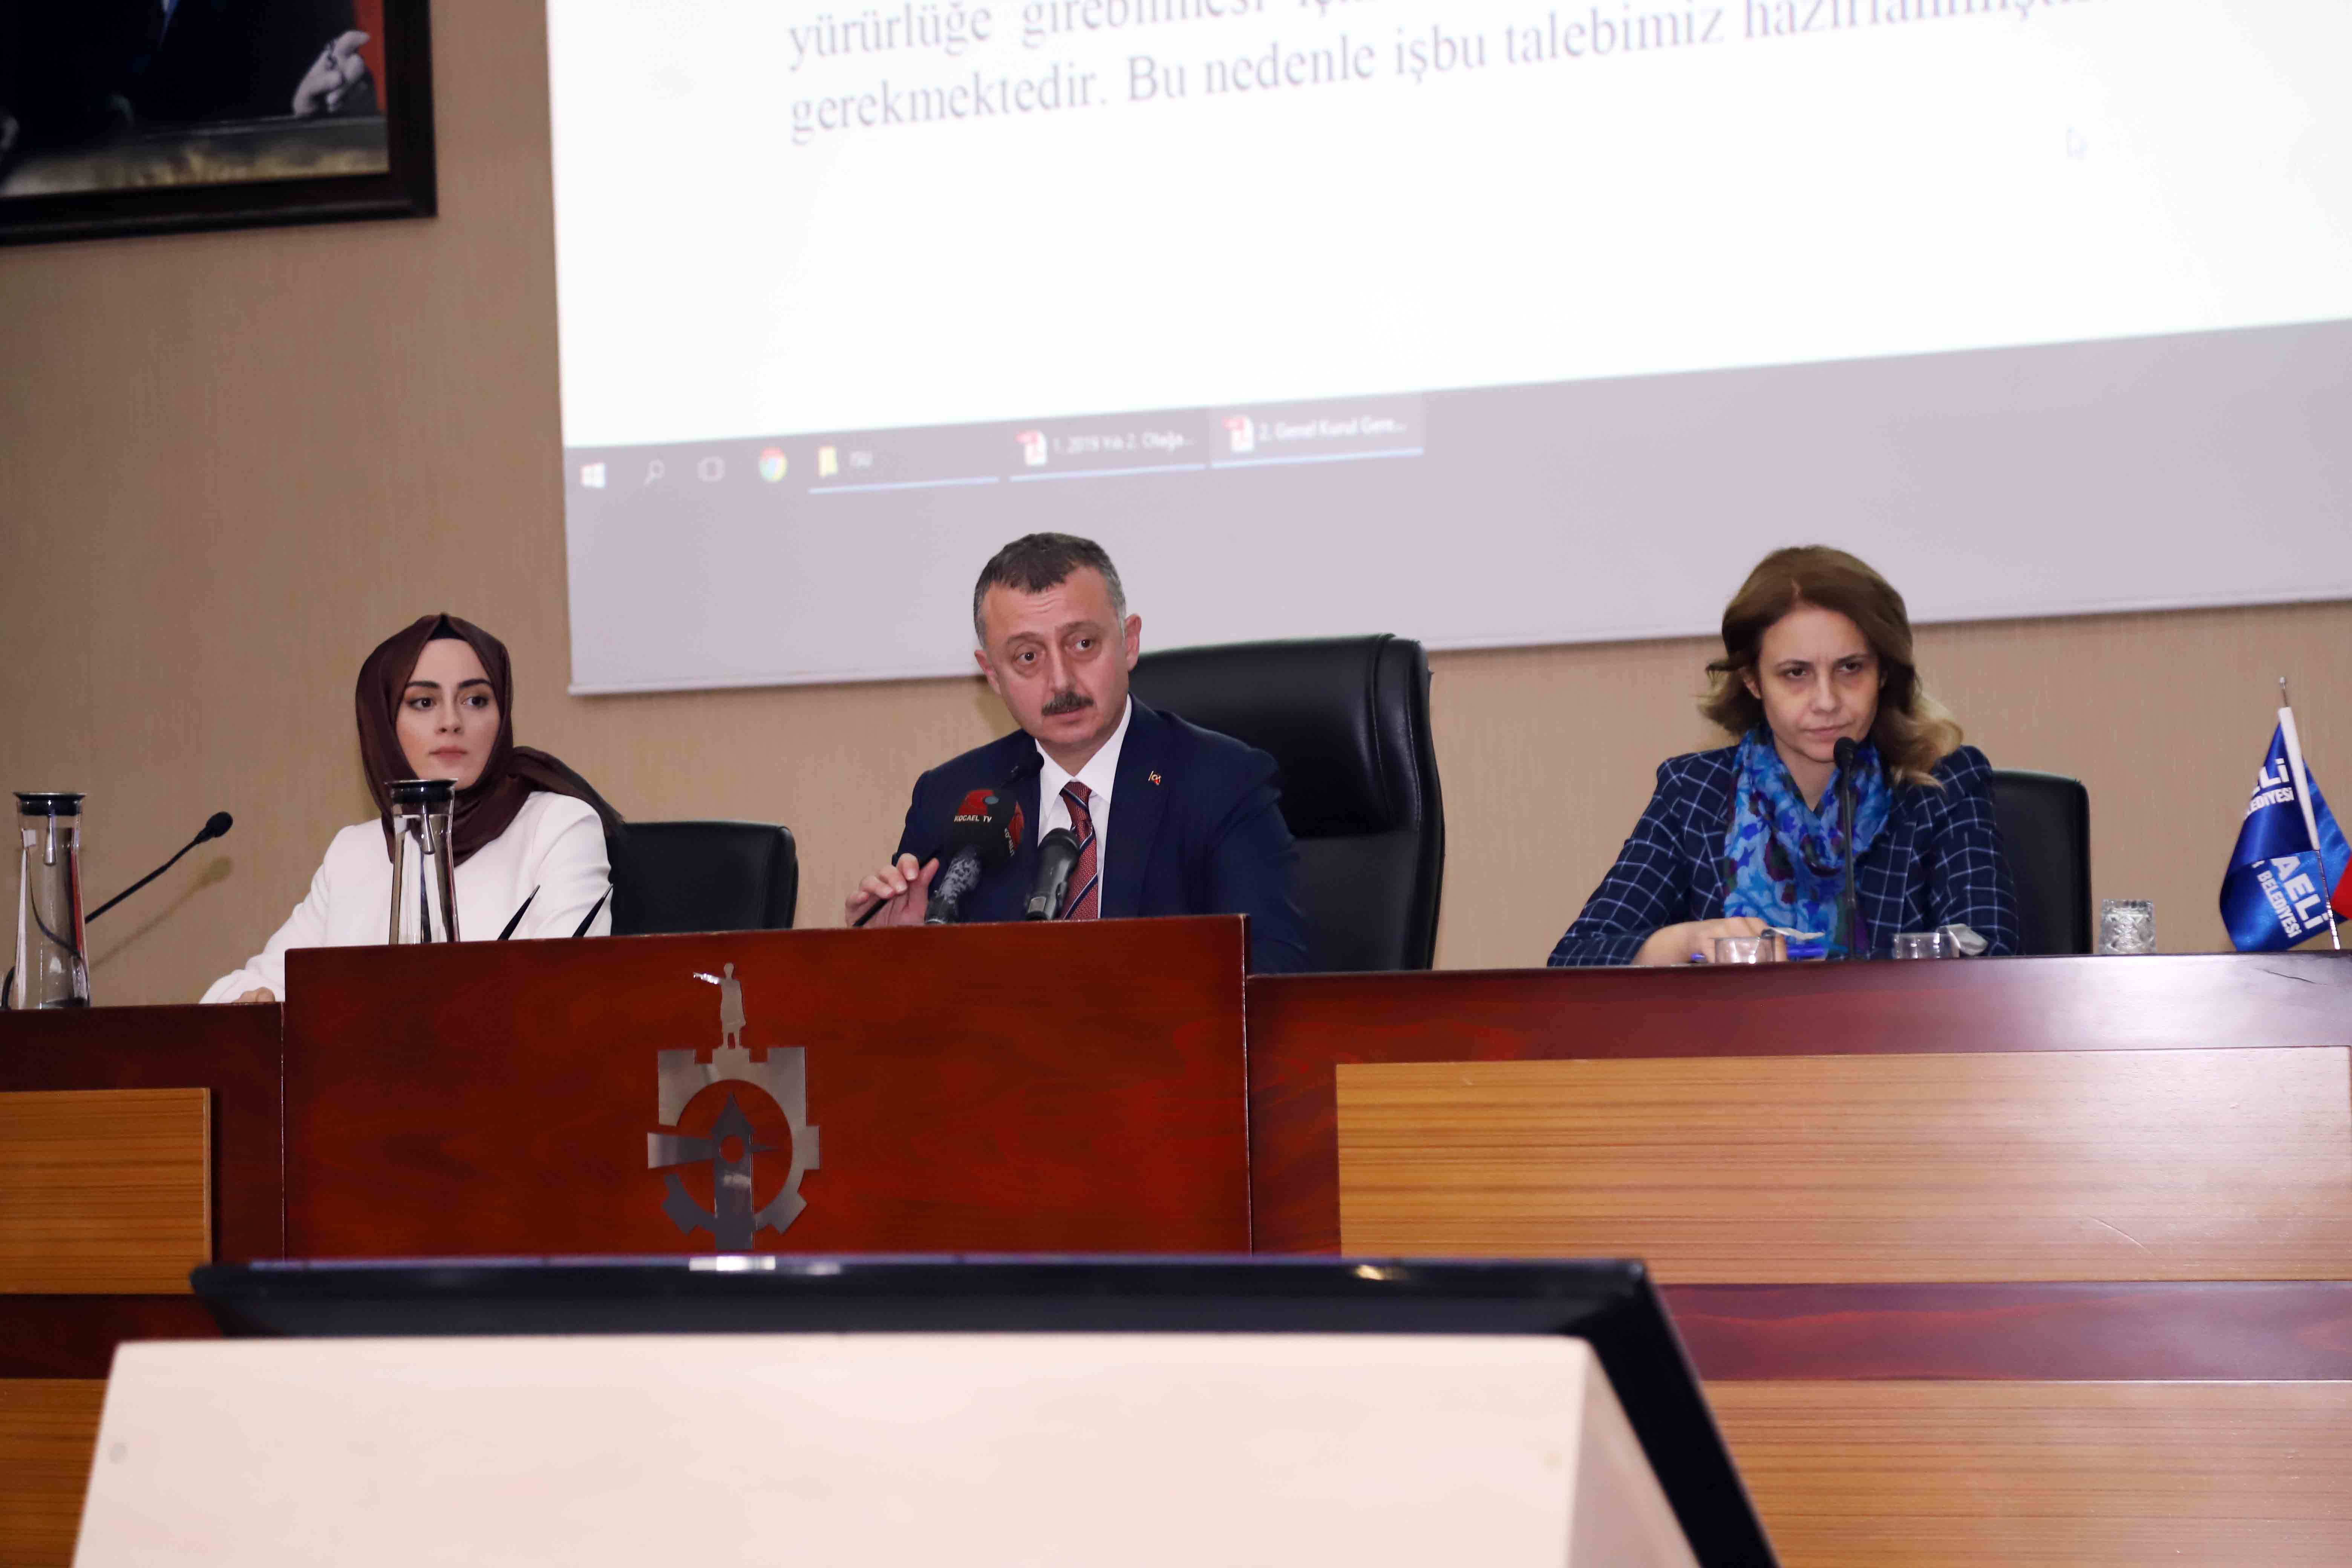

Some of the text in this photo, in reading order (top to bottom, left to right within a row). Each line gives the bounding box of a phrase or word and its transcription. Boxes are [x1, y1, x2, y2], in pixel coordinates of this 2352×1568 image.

[788, 0, 992, 72] yürürlüğe
[790, 61, 1107, 146] gerekmektedir.
[1127, 54, 1187, 102] Bu
[1204, 31, 1377, 93] nedenle
[1395, 23, 1488, 84] işbu
[1505, 0, 1726, 65] talebimiz
